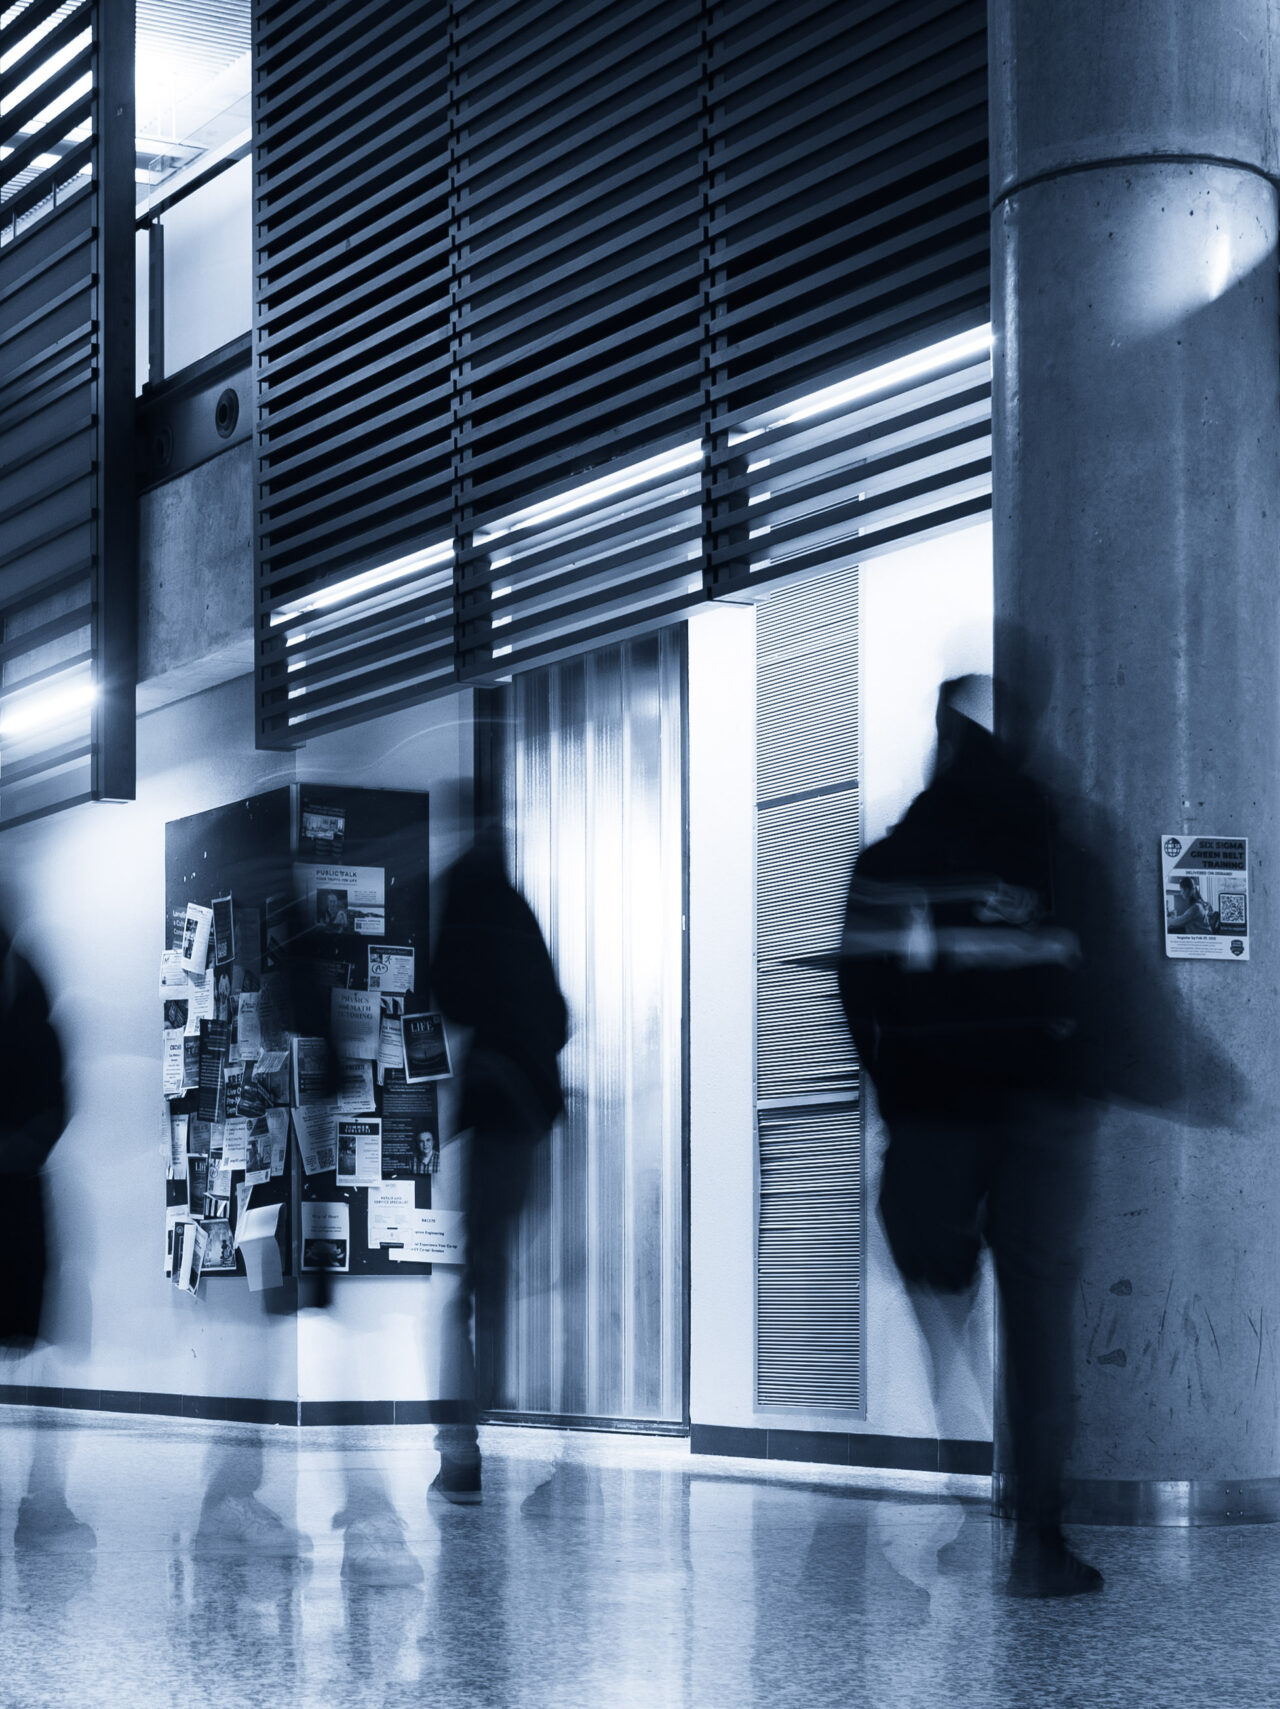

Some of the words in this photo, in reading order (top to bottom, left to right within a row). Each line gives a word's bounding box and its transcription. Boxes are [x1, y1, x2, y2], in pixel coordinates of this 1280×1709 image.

[1198, 840, 1214, 849] SIX
[1215, 841, 1243, 849] SIGMA
[1190, 850, 1221, 858] GREEN
[1222, 851, 1243, 859] BELT
[1201, 860, 1243, 869] TRAINING
